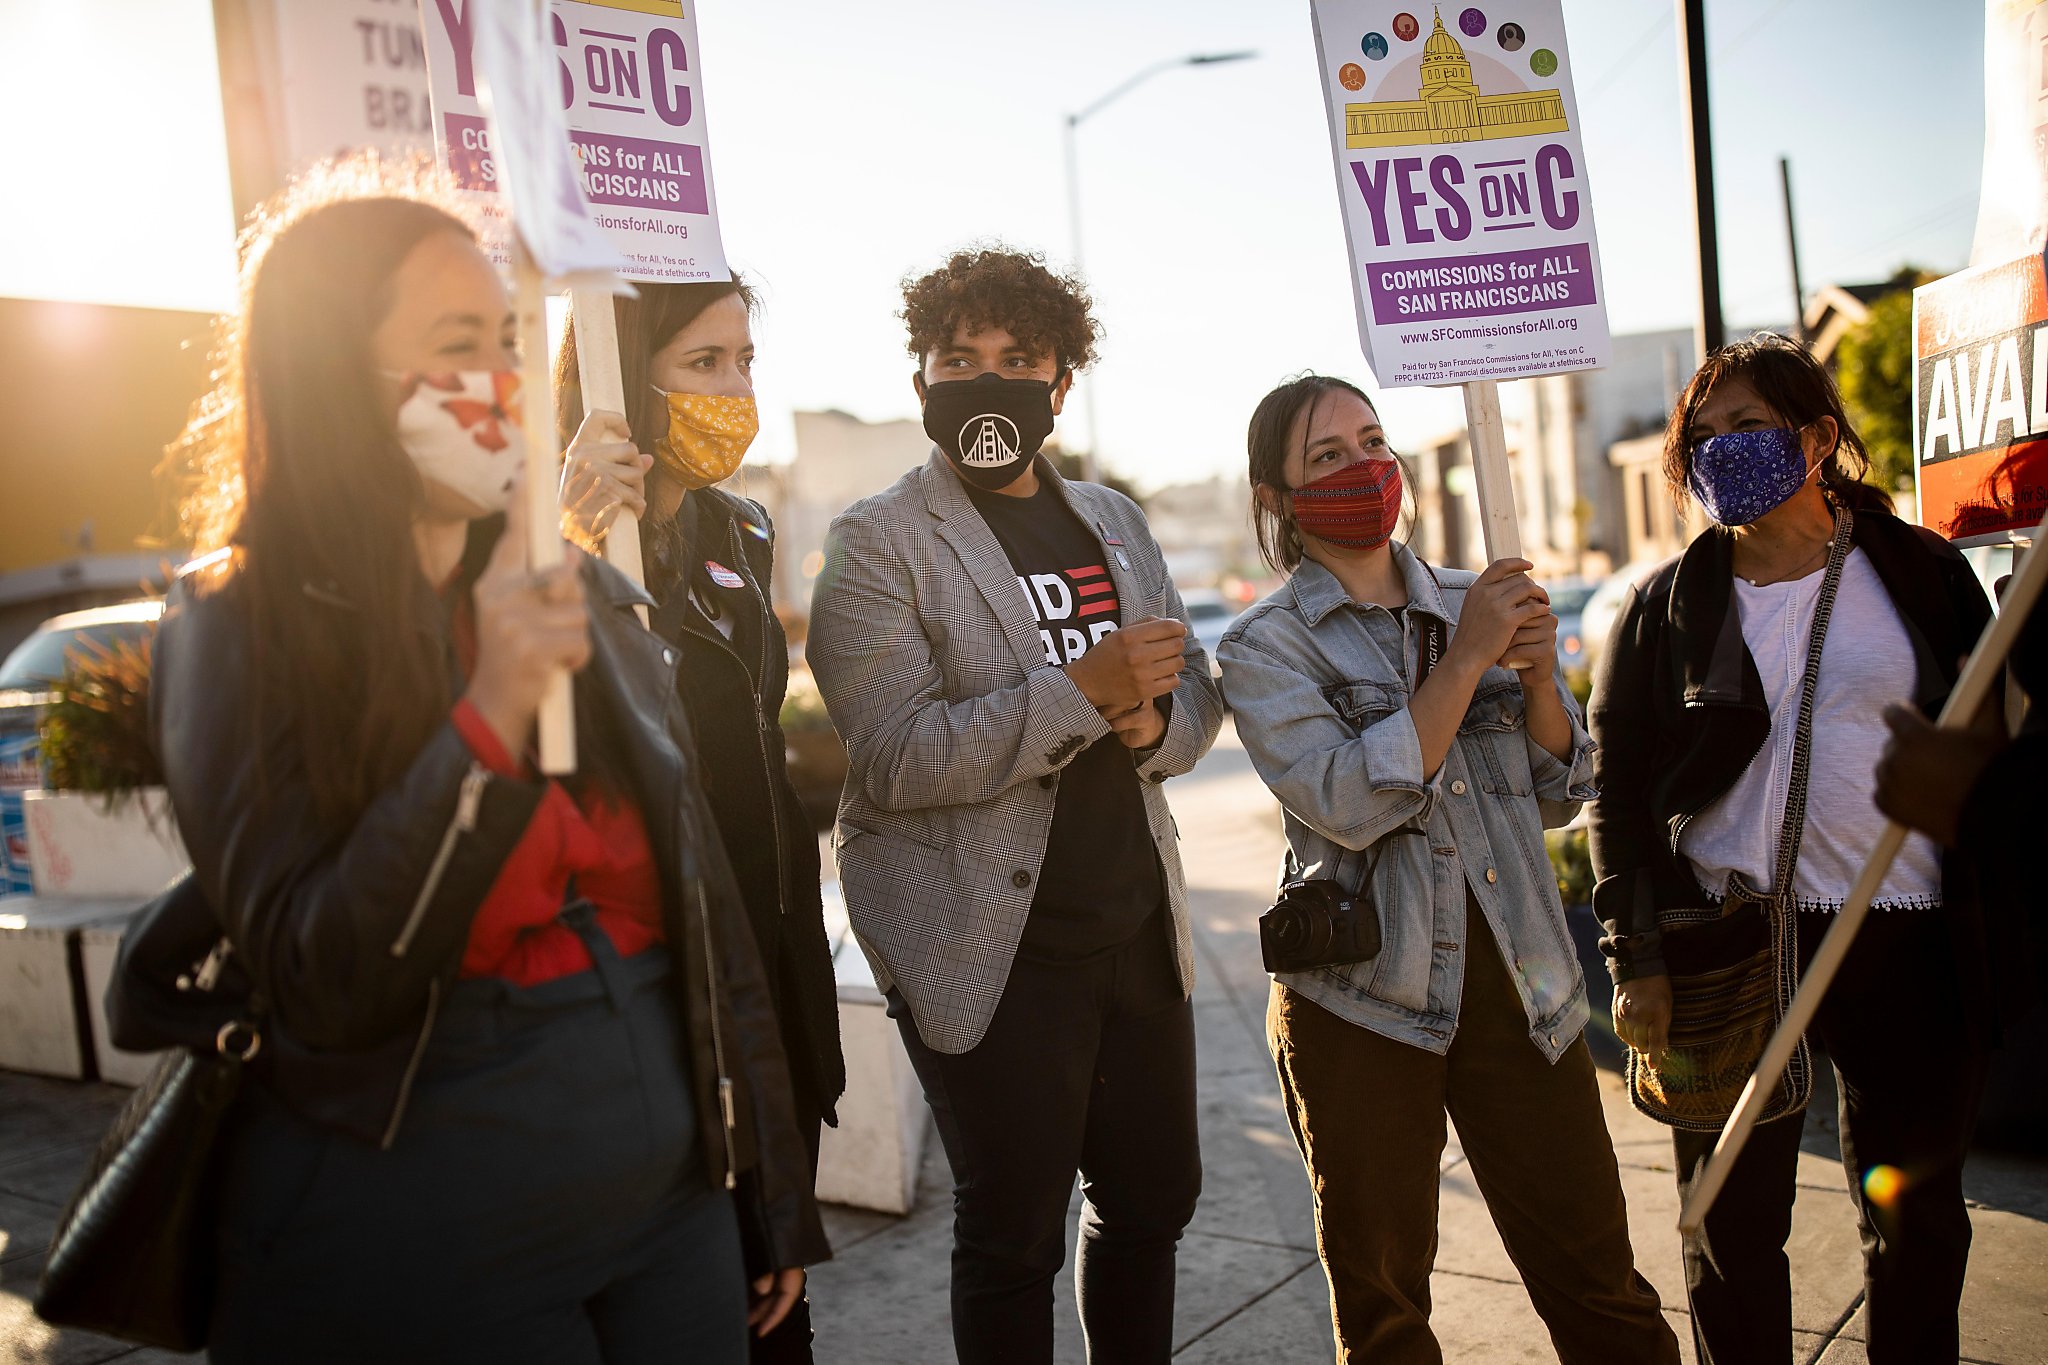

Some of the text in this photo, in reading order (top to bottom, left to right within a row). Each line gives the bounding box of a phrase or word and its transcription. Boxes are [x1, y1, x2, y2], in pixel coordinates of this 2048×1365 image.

[585, 44, 641, 99] ON
[646, 27, 692, 127] C
[615, 147, 645, 171] for
[652, 151, 691, 177] ALL
[1350, 143, 1580, 247] YES ON C
[622, 266, 655, 276] available
[656, 268, 664, 276] at
[665, 269, 711, 278] sfethics.org
[637, 254, 648, 263] for
[649, 255, 661, 264] All,
[662, 256, 676, 265] Yes
[678, 258, 687, 266] on
[689, 258, 695, 266] C
[1381, 255, 1580, 291] COMMISSIONS for ALL
[1397, 281, 1570, 315] SAN FRANCISCANS
[1400, 316, 1578, 344] www.SFCommissionsforAll.org
[1394, 372, 1413, 383] FPPC
[1413, 370, 1444, 382] #1427233
[1449, 367, 1479, 379] Financial
[1479, 364, 1517, 376] disclosures
[1517, 361, 1547, 373] available
[1548, 361, 1556, 369] at
[1556, 356, 1597, 369] sfethics.org
[1402, 346, 1585, 371] Paid for by San Francisco Commissions for All, Yes on C
[1922, 327, 2048, 461] AVAL
[1954, 499, 1969, 516] Paid
[1971, 498, 1981, 513] for
[1982, 497, 1992, 512] by
[2021, 489, 2034, 504] for
